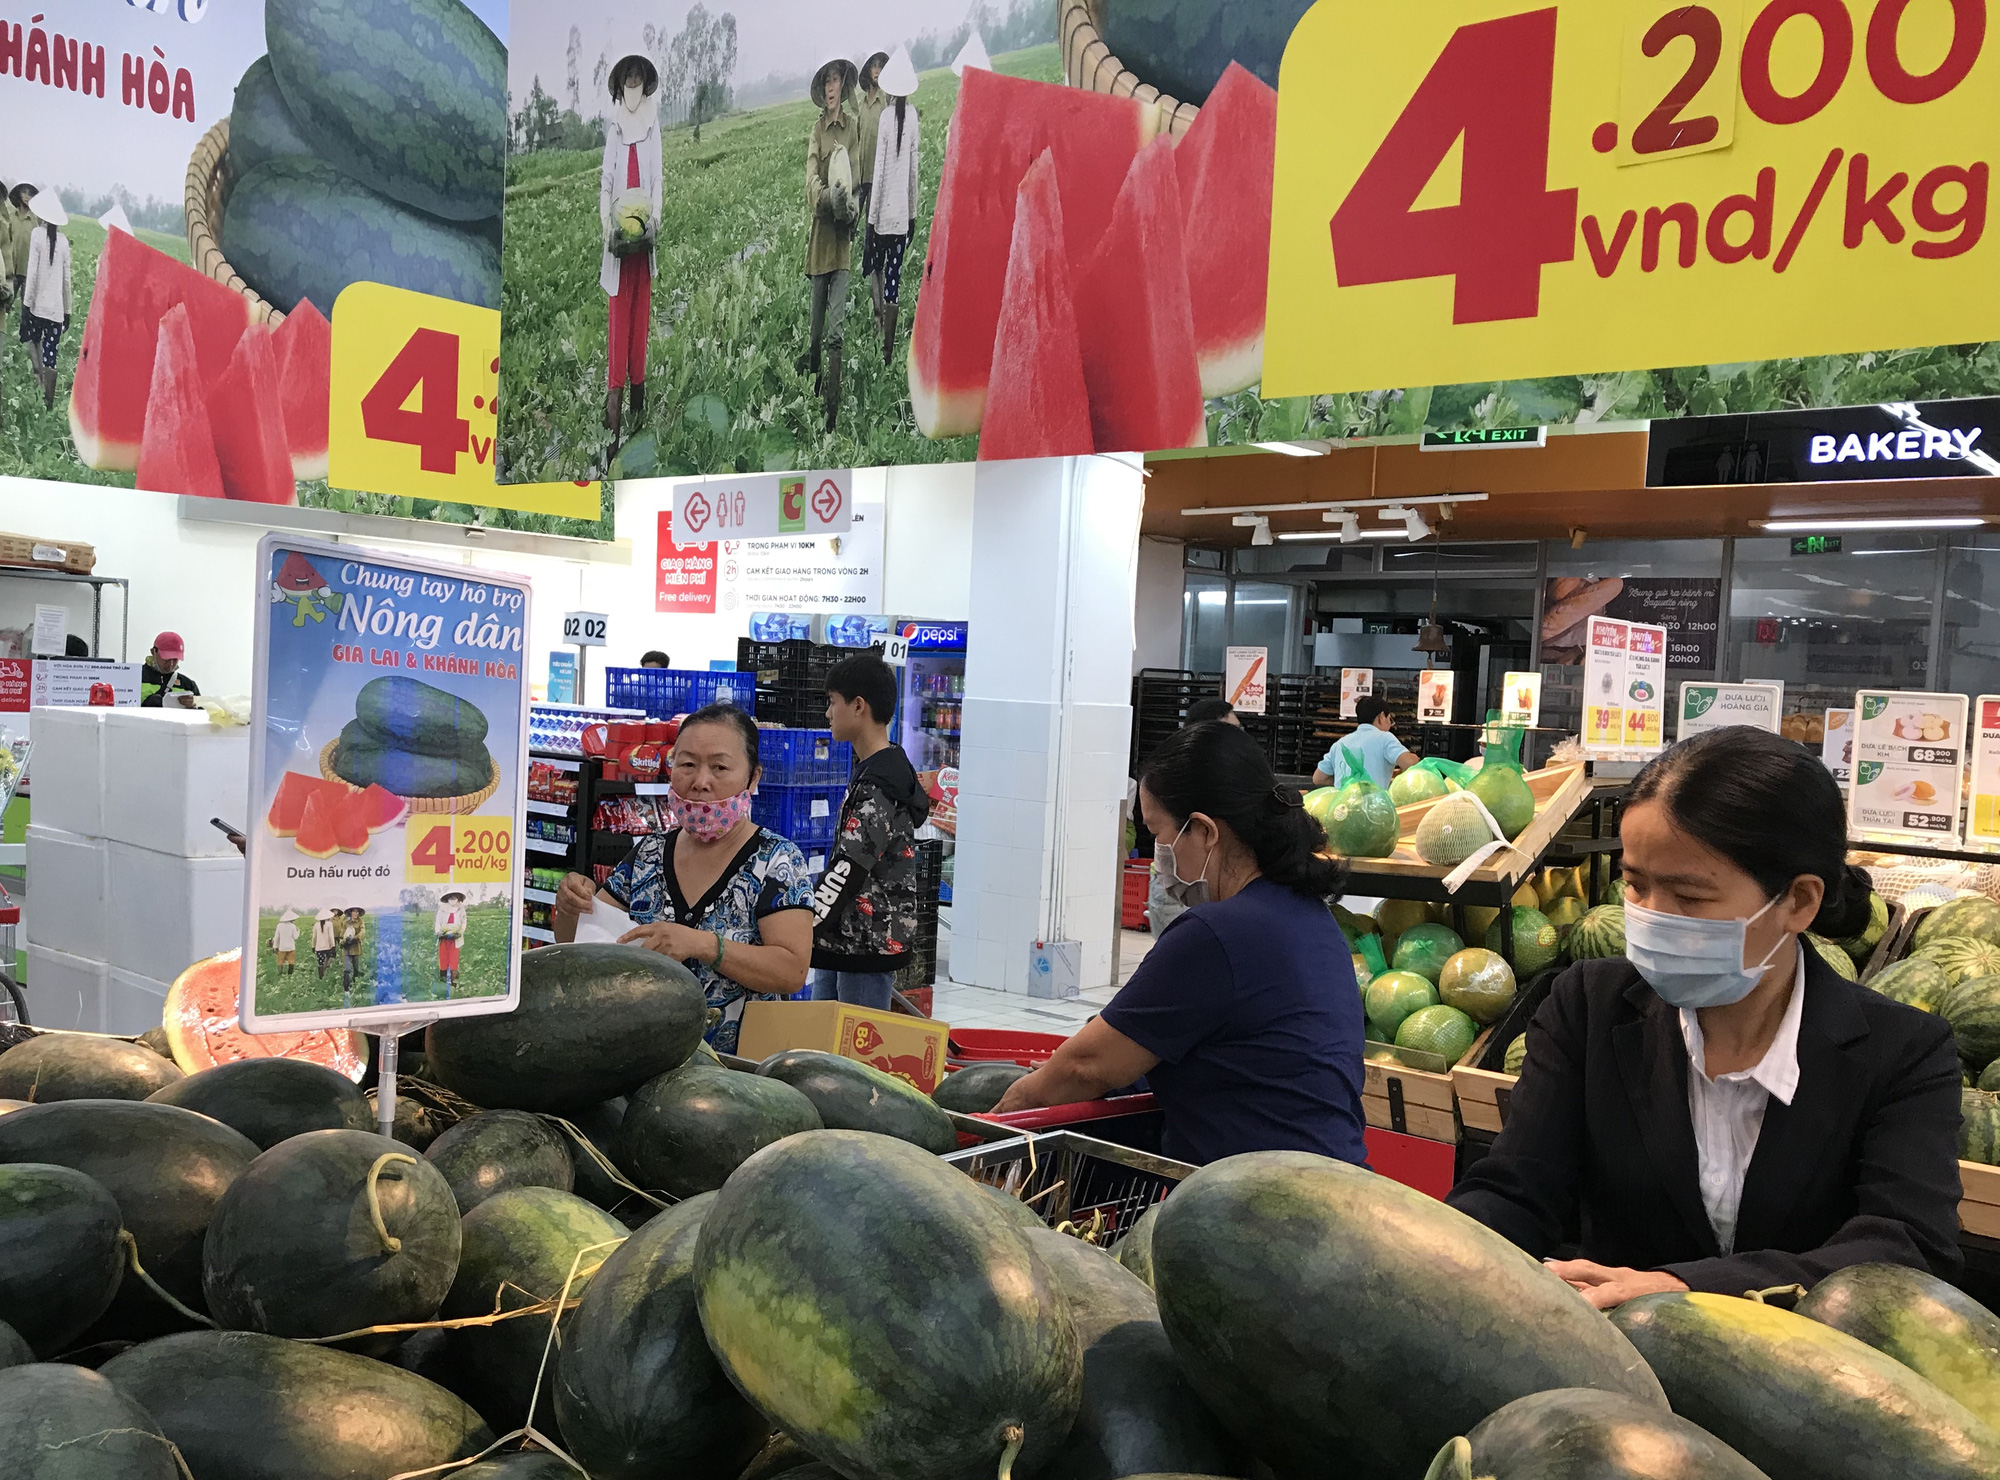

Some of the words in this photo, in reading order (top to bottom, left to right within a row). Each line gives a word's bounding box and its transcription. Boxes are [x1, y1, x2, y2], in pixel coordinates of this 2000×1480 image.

[121, 45, 195, 123] HÒA
[1580, 147, 1989, 279] vnd/kg
[1491, 429, 1528, 441] EXIT
[1810, 427, 1982, 464] BAKERY
[782, 483, 796, 495] Big
[783, 482, 805, 520] C
[770, 542, 789, 551] PHẠM
[661, 557, 684, 570] GIAO
[685, 555, 713, 570] HÀNG
[726, 565, 737, 575] 2h
[690, 570, 707, 585] PHÍ
[761, 566, 773, 575] KẾT
[341, 562, 414, 598] Chung
[420, 576, 456, 604] tay
[491, 587, 524, 614] trợ
[659, 592, 677, 602] Free
[678, 592, 711, 604] delivery
[761, 594, 777, 602] GIAN
[338, 592, 444, 650] Nông
[453, 611, 523, 652] dân
[564, 618, 580, 636] 02
[584, 619, 606, 639] 02
[1687, 622, 1717, 631] 12h00
[921, 627, 956, 644] pepsi
[890, 642, 907, 659] 01
[1670, 644, 1700, 653] 16h00
[332, 644, 363, 664] GIA
[369, 647, 399, 668] LAI
[405, 651, 418, 669] &
[423, 652, 479, 676] KHÁNH
[485, 658, 517, 680] HÒA
[1668, 655, 1701, 664] 20h00
[1724, 692, 1743, 701] DƯA
[1753, 704, 1769, 712] GIA
[1628, 712, 1646, 732] 44
[632, 757, 660, 769] Skittles
[1913, 749, 1935, 762] 68
[1907, 814, 1930, 828] 52
[456, 854, 508, 872] vnd/kg
[287, 866, 315, 879] Dưa
[319, 864, 344, 879] hấu
[347, 867, 372, 880] ruột
[375, 863, 391, 878] đỏ
